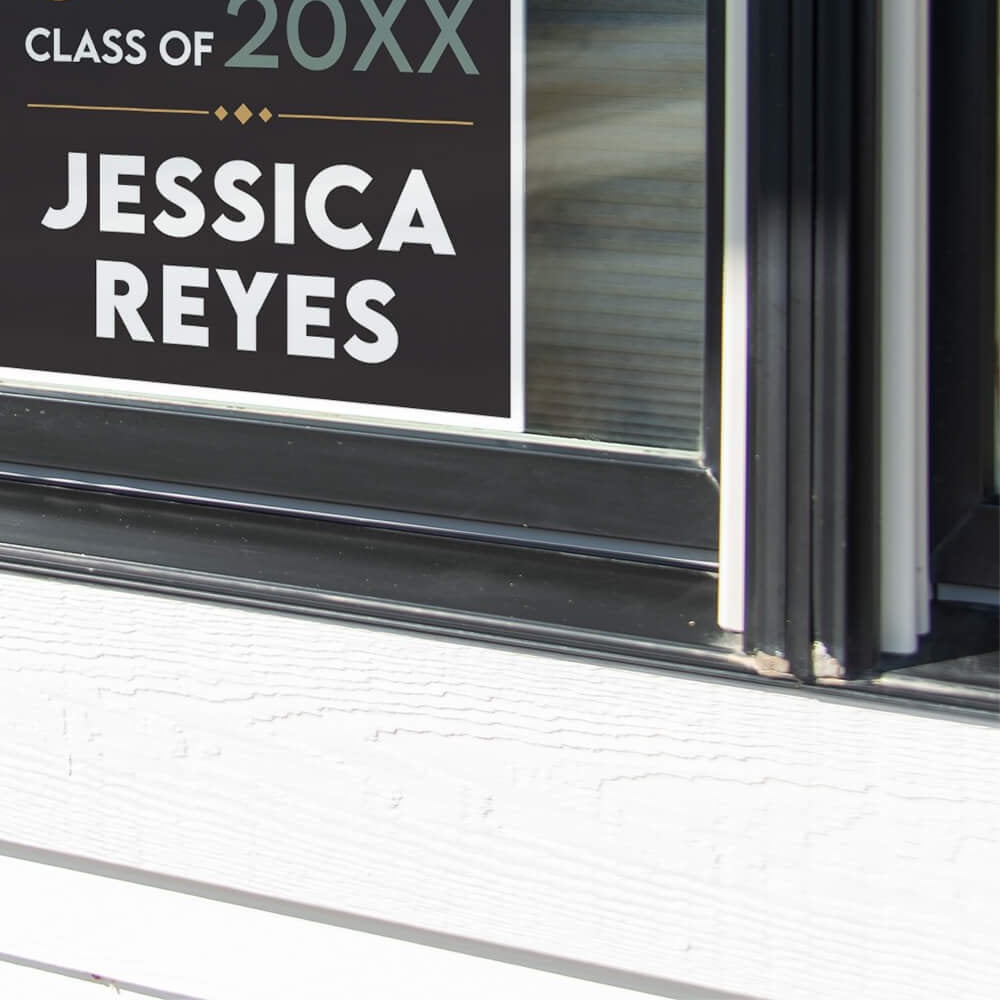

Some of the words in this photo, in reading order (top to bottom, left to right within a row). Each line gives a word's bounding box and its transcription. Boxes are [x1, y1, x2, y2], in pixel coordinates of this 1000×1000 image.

[24, 27, 147, 65] CLASS
[159, 30, 214, 67] OF
[40, 151, 457, 256] JESSICA
[95, 259, 399, 364] REYES
